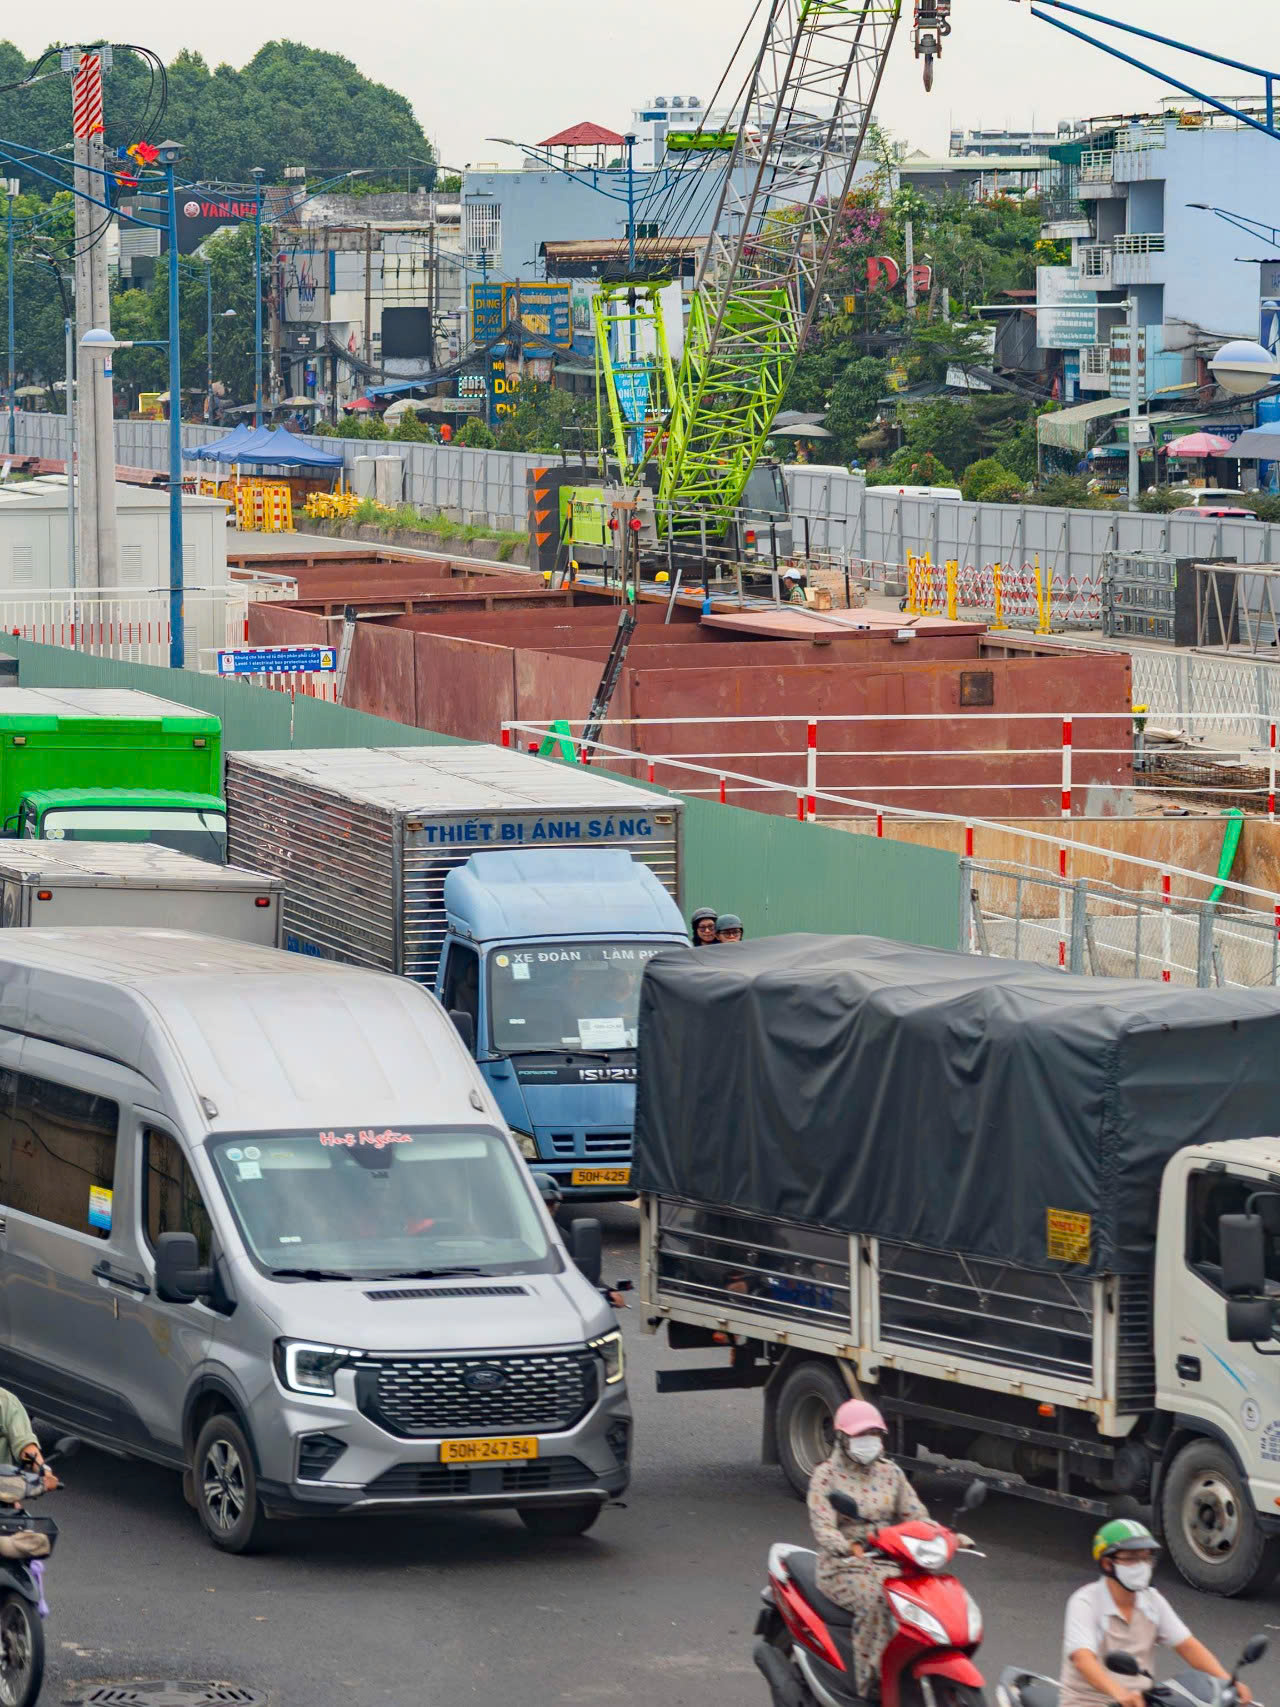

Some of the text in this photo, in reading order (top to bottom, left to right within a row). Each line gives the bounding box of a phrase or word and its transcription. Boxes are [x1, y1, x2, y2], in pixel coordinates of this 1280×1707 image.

[461, 379, 486, 389] SOFA
[424, 816, 653, 845] THIẾT BỊ ÁNH SÁNG
[513, 953, 534, 963] XE
[537, 948, 582, 962] ĐOÀN
[602, 948, 635, 960] LÀM
[578, 1068, 638, 1081] ISUZU
[447, 1441, 530, 1459] 50H-247.54
